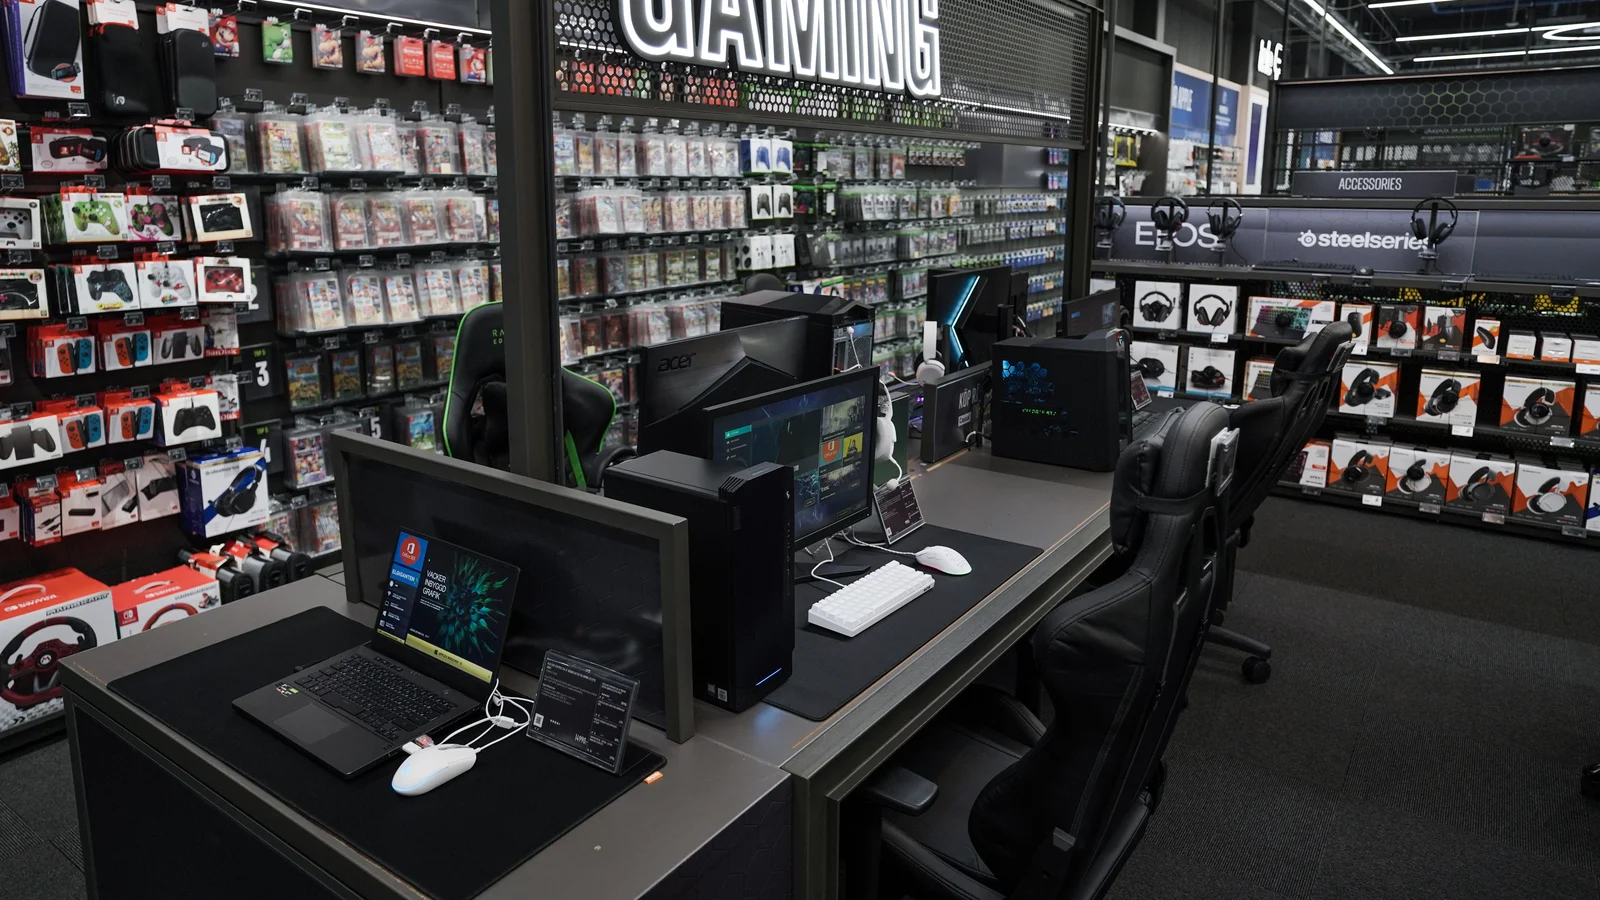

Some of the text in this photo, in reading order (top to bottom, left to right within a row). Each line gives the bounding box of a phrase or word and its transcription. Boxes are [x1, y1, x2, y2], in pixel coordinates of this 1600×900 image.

[1338, 177, 1402, 191] ACCESSORIES
[1135, 220, 1217, 248] EOS
[657, 352, 697, 372] acer
[255, 360, 270, 387] 3
[370, 416, 382, 439] 5
[426, 569, 447, 582] VACKER
[422, 587, 441, 600] GRAFIK
[424, 579, 447, 593] INBYGGD
